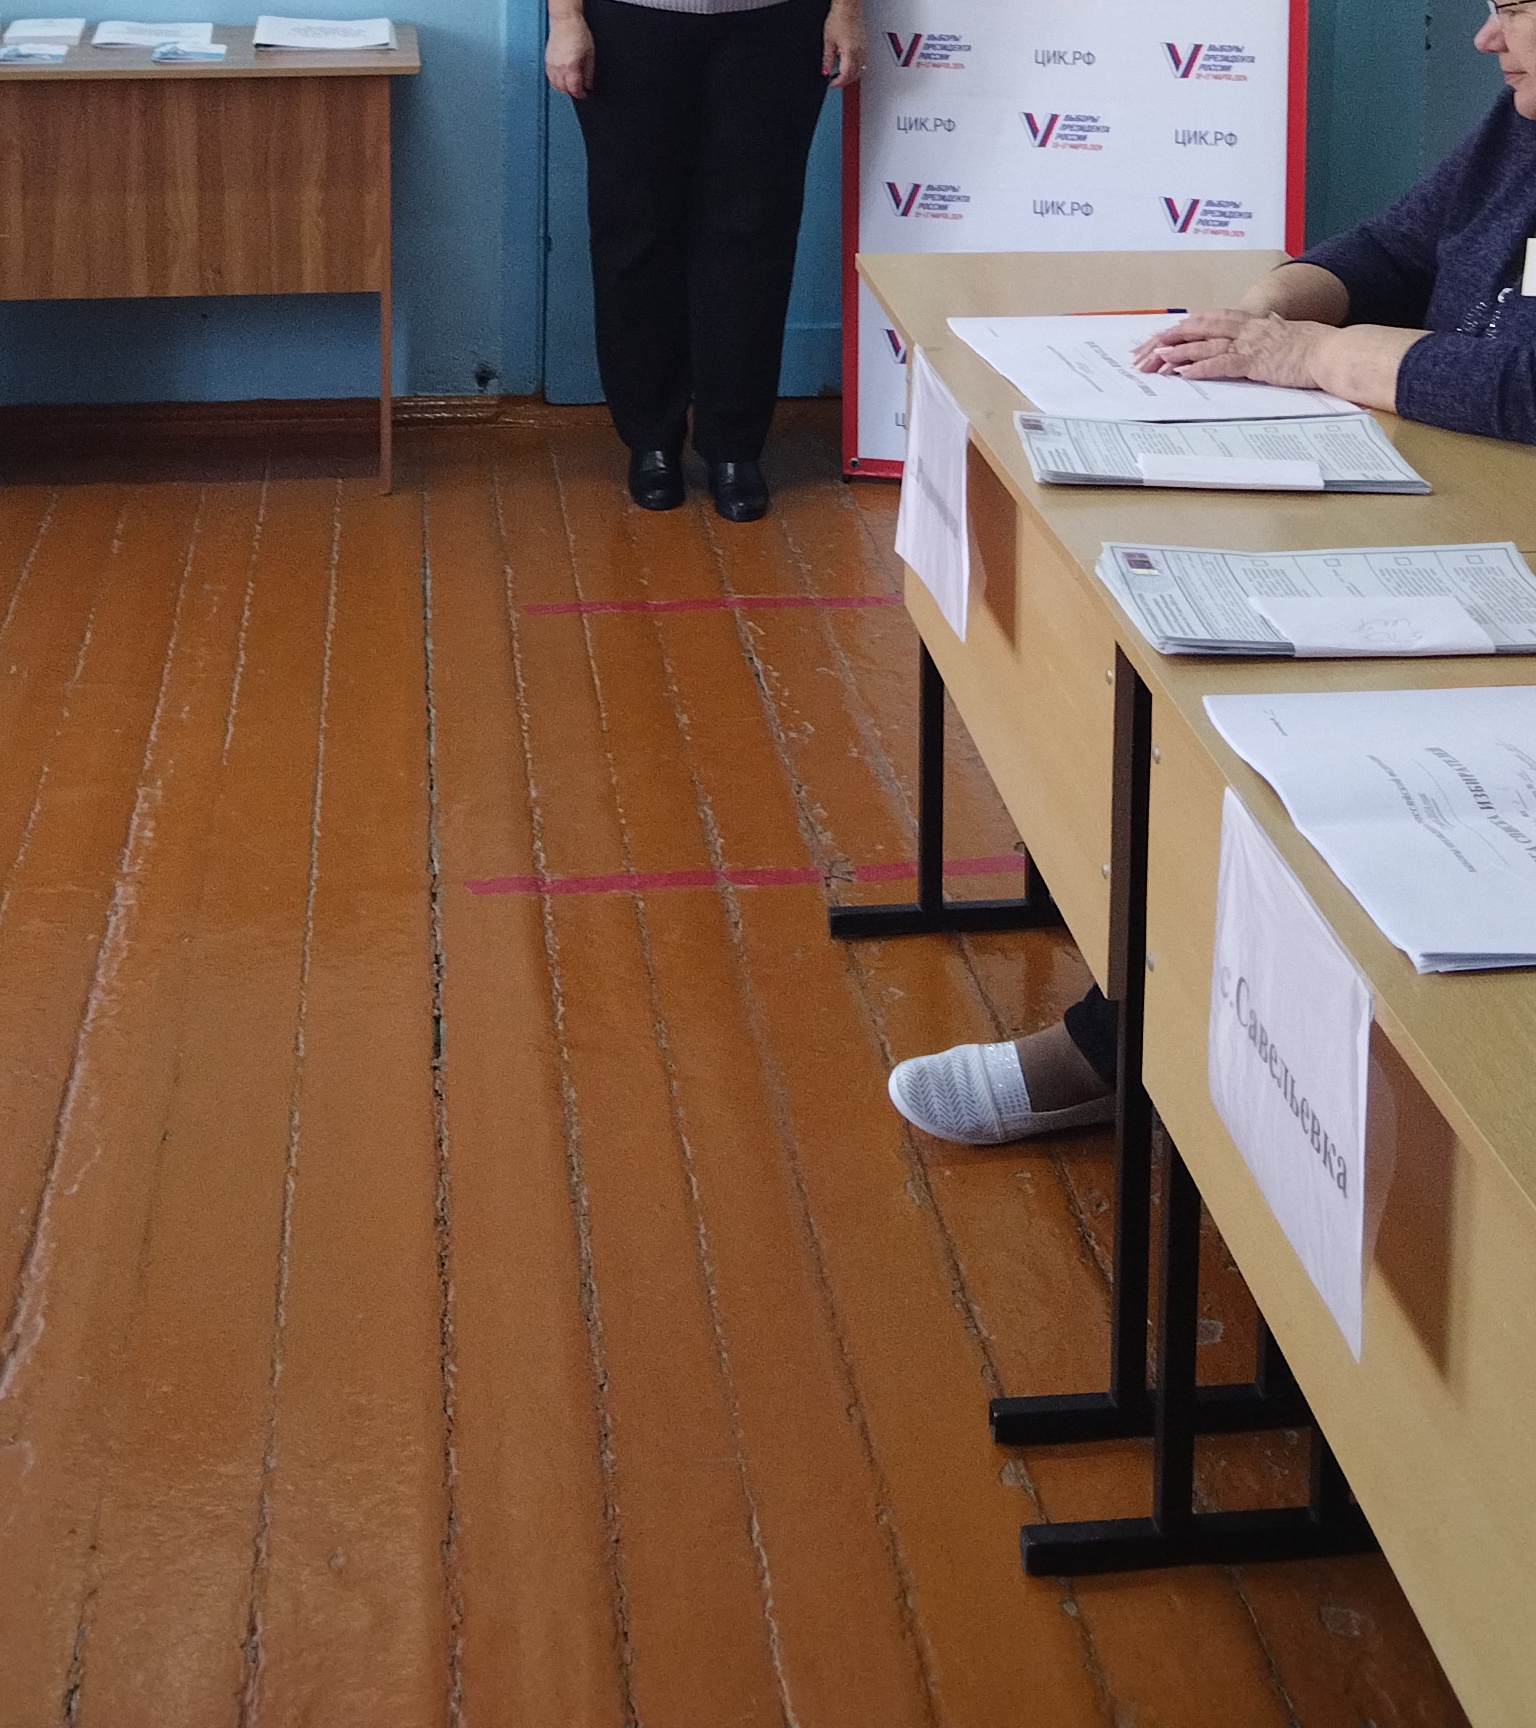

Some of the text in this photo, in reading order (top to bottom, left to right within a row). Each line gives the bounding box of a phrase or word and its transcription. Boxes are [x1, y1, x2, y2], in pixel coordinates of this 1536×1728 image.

[1034, 49, 1096, 67] ЦИК.РФ
[896, 115, 956, 134] ЦИК.РФ
[1174, 129, 1238, 148] ЦИК.РФ
[1032, 199, 1094, 217] ЦИК.РФ
